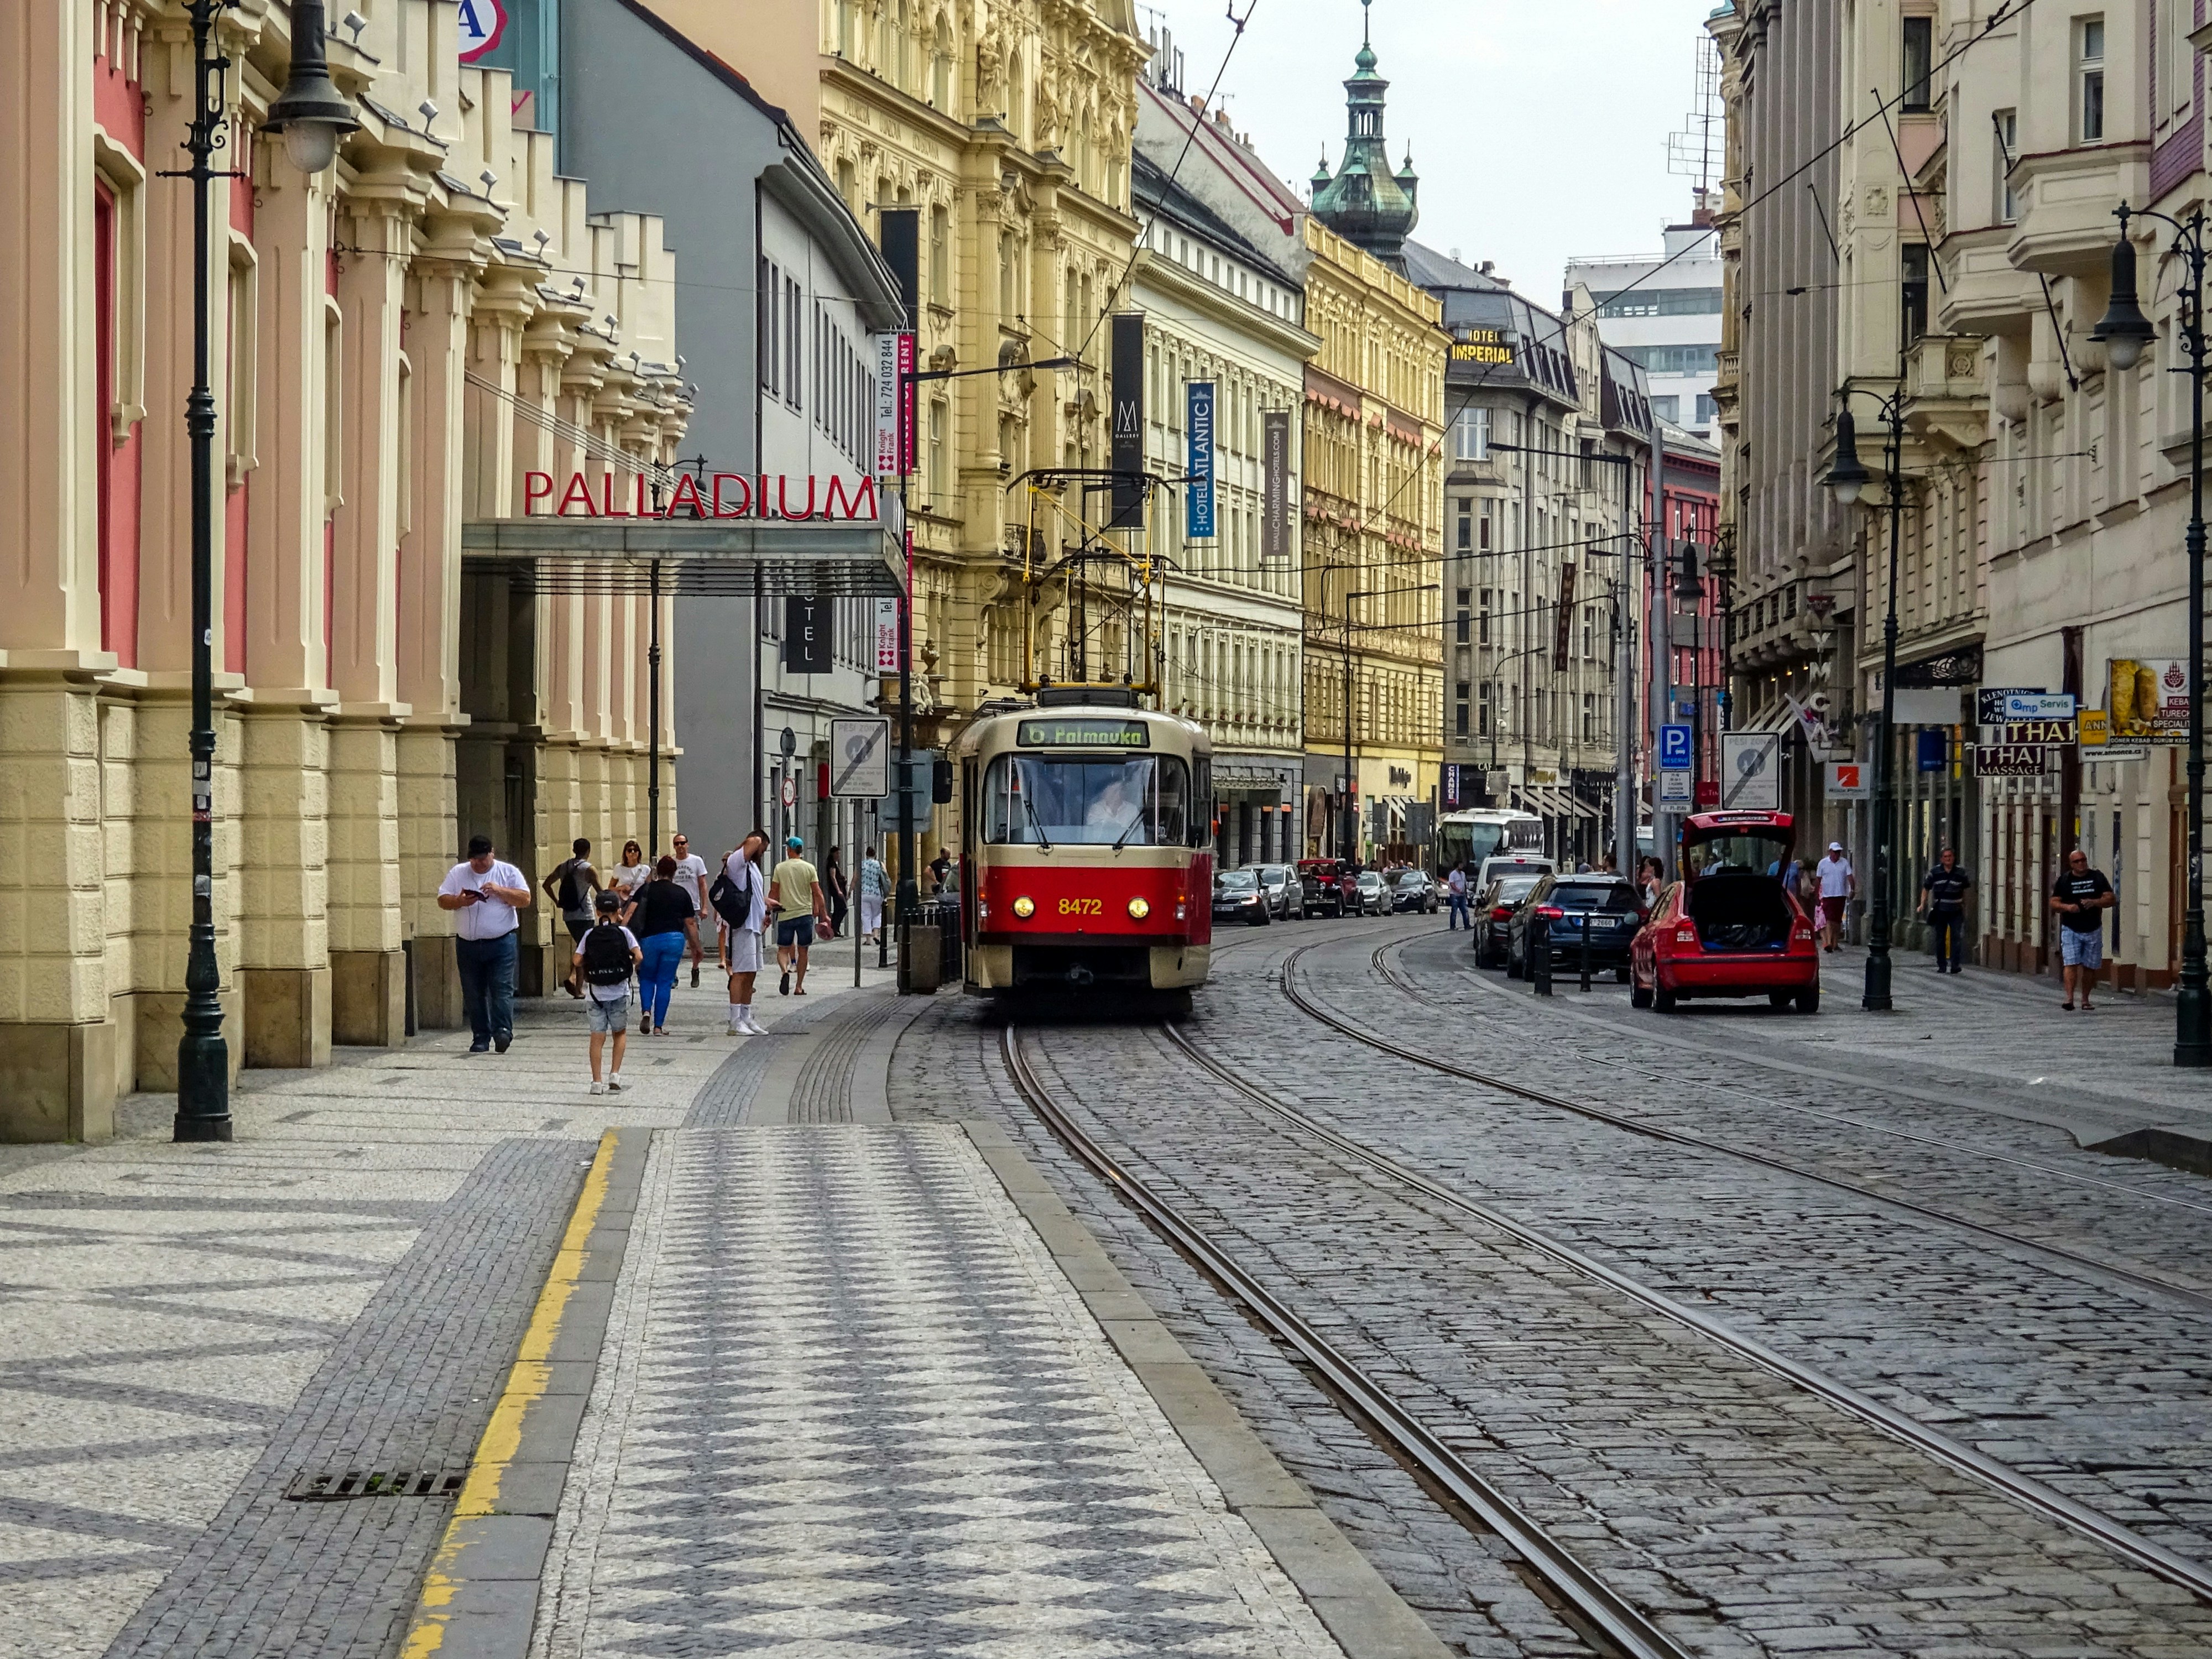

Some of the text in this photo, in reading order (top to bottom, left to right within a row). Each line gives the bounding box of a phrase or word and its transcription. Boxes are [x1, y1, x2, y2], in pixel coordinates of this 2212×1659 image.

[901, 340, 909, 374] RENT
[1452, 344, 1514, 364] IMPERIAL
[880, 340, 893, 418] Tel.: 724 032 844
[878, 429, 888, 453] Knight
[1194, 403, 1209, 524] HOTEL ATLANTIC
[524, 471, 878, 520] PALLADIUM
[1272, 431, 1281, 551] SMALLCHARMINGHOTELS.COM
[804, 596, 815, 661] TEL
[1809, 632, 1832, 748] YMCA
[2039, 699, 2069, 708] Servis
[1055, 726, 1141, 745] Palmovka
[1667, 729, 1685, 755] P
[2007, 722, 2073, 742] THAI
[1980, 747, 2042, 765] THAI
[1979, 765, 2041, 775] MASSAGE
[1058, 898, 1102, 915] 8472
